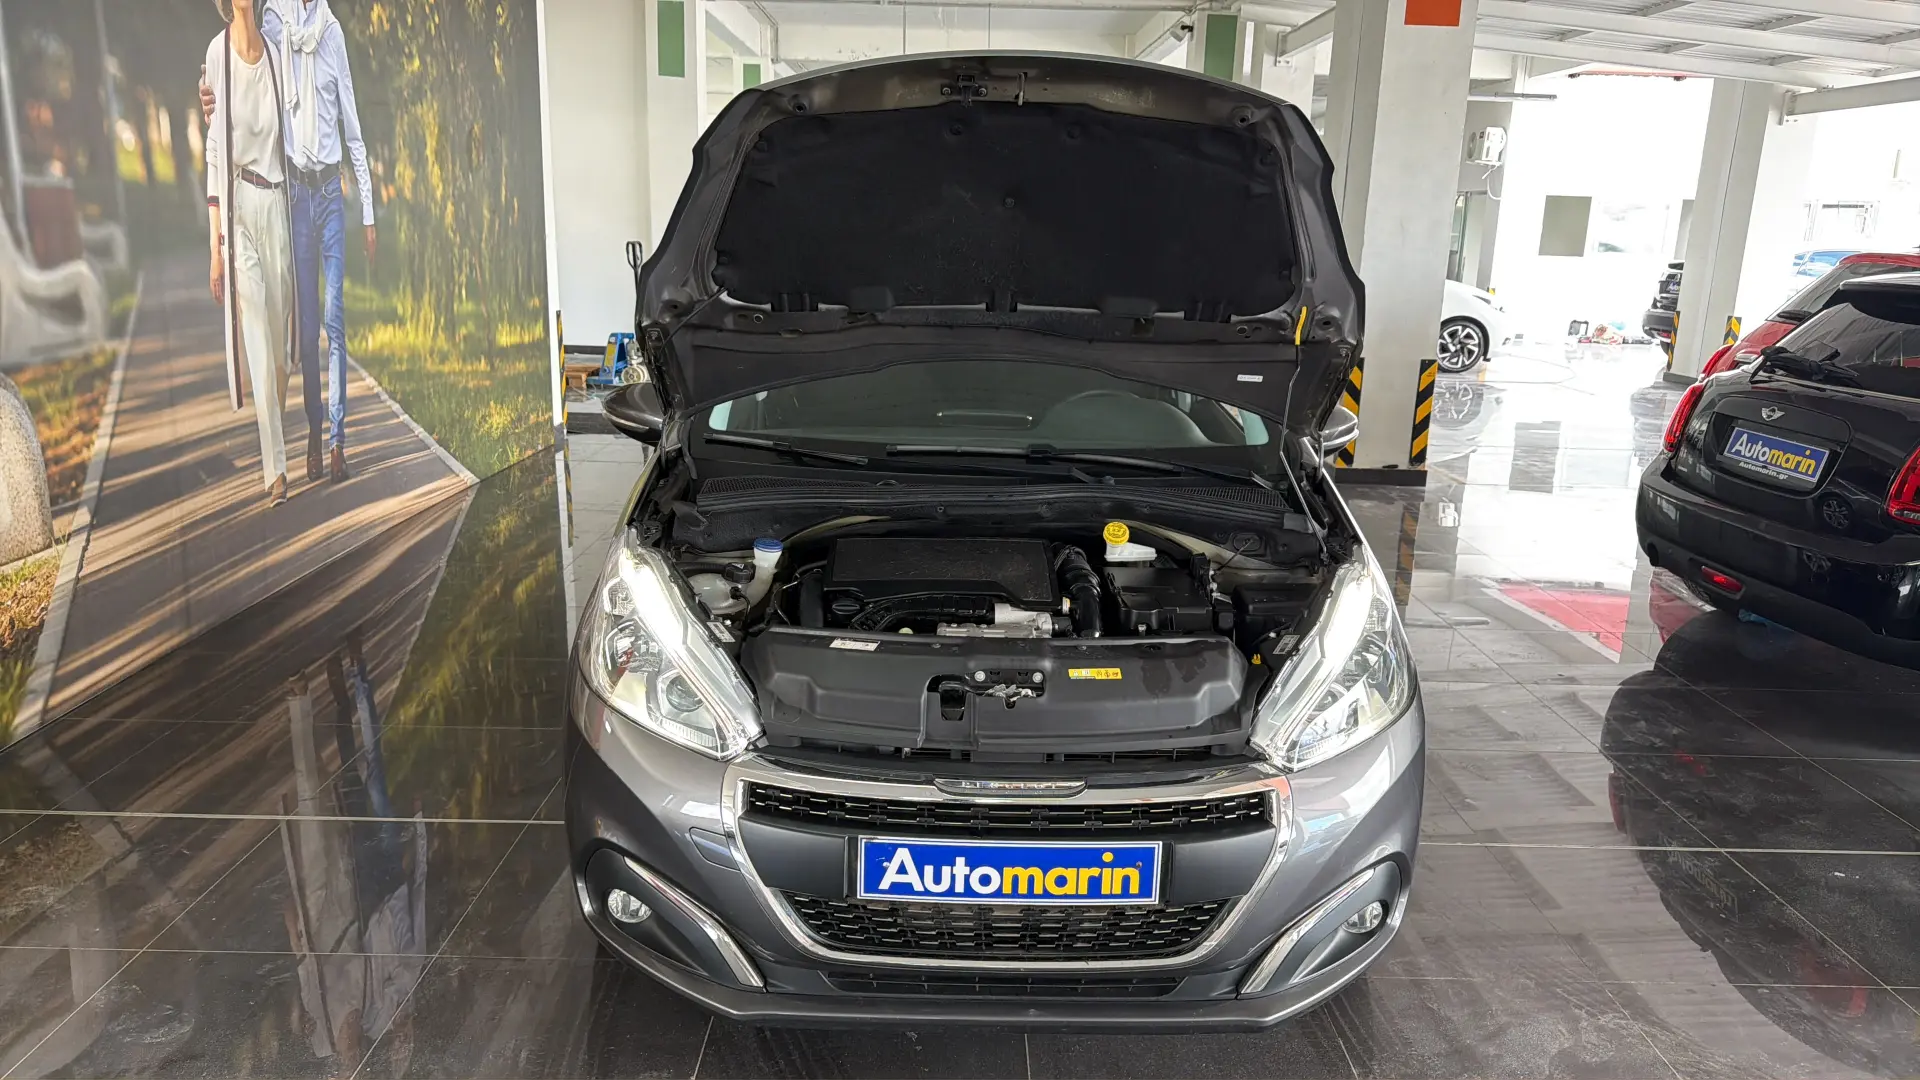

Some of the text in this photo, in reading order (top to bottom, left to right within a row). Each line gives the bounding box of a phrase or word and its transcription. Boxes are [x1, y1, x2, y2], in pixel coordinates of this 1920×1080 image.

[1731, 433, 1816, 475] Automarin
[1739, 461, 1789, 480] Automarin.gr
[878, 847, 1141, 895] Automarin
